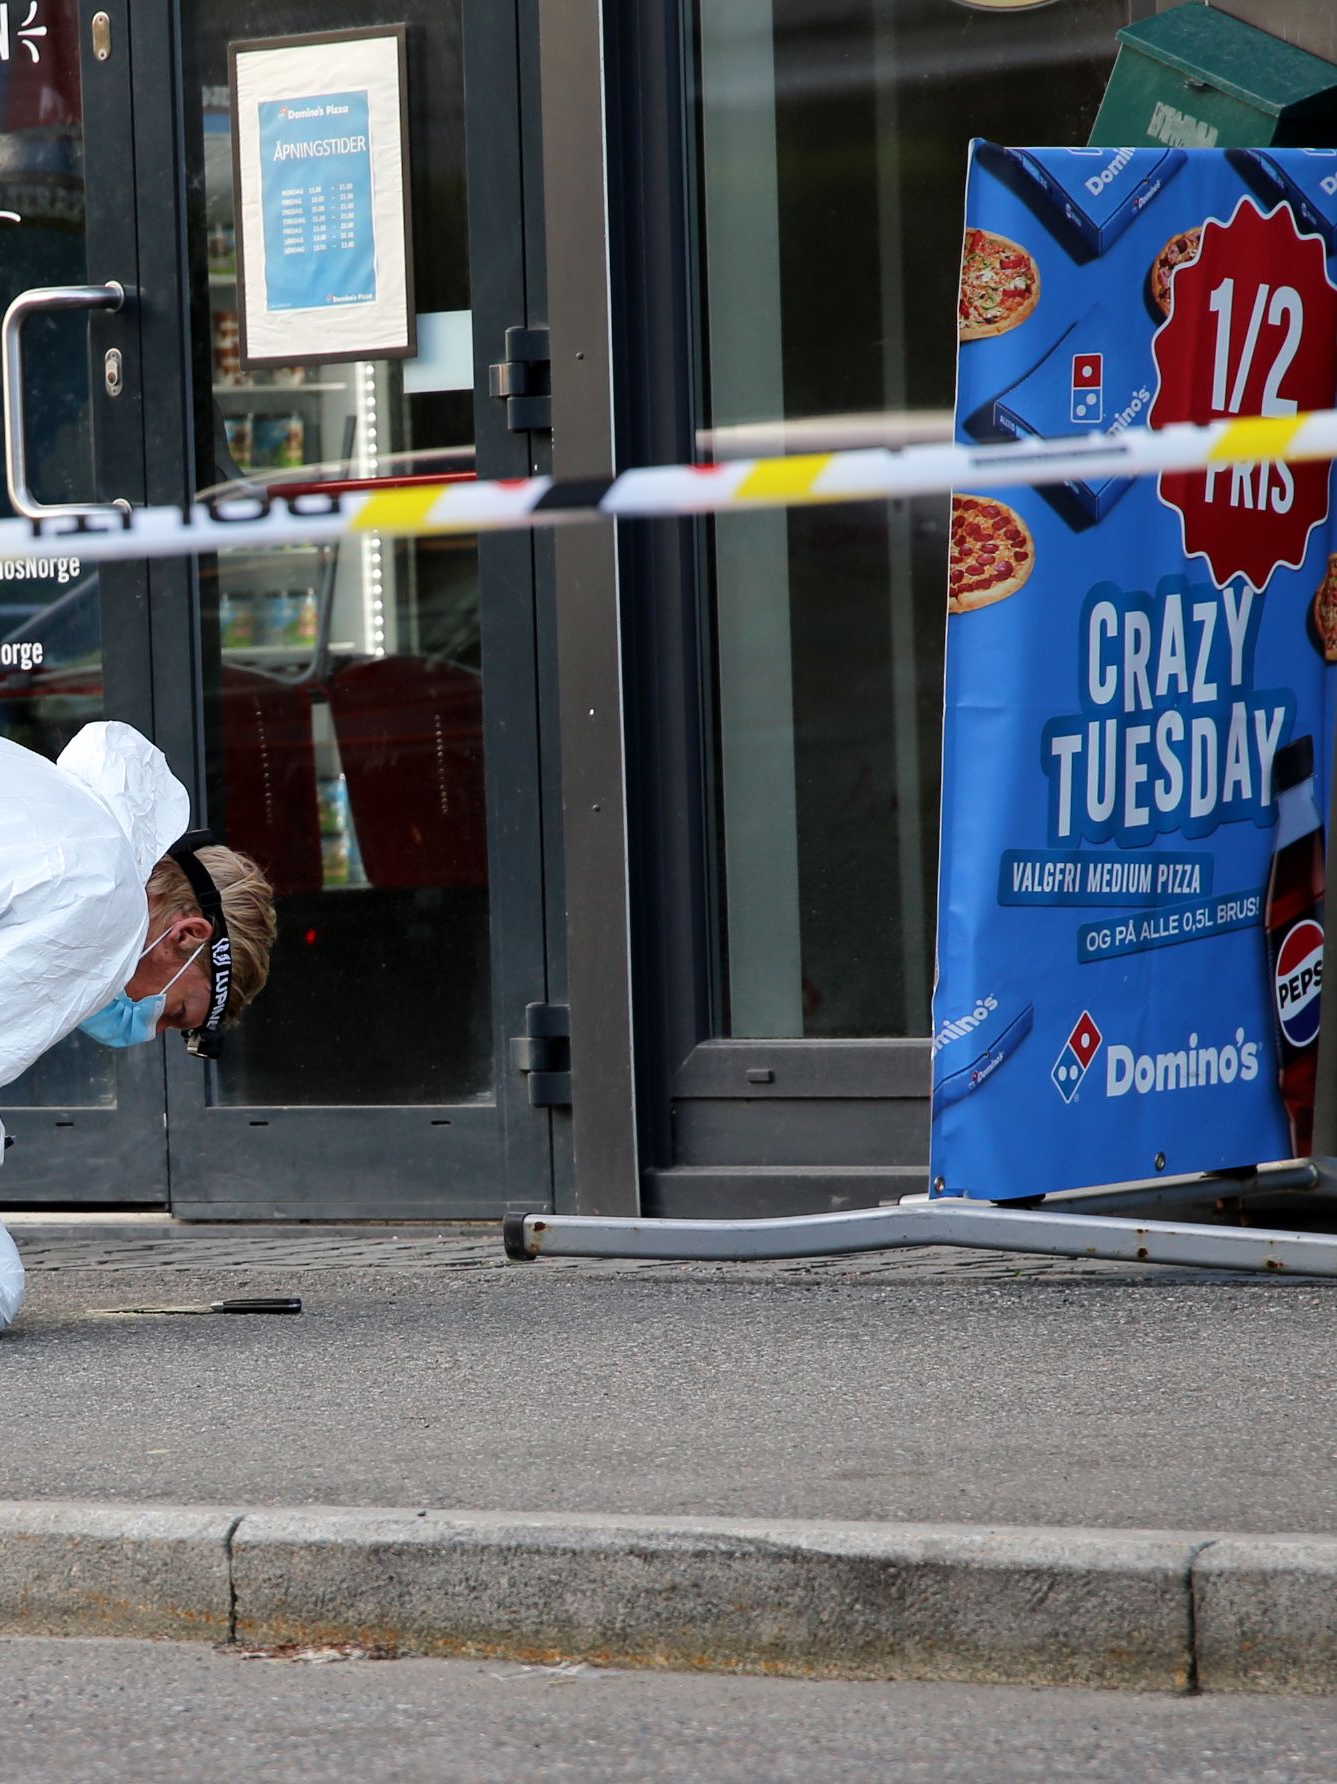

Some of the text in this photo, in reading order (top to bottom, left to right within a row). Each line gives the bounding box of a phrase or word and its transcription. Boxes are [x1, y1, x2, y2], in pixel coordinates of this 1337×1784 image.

[326, 104, 349, 115] Pizza
[273, 136, 366, 161] ÅPNINGSTIDER
[1209, 277, 1304, 419] 1/2
[1088, 586, 1254, 713] CRAZY
[1051, 701, 1286, 837] TUESDAY
[1013, 862, 1201, 894] VALGFRI MEDIUM PIZZA
[1086, 896, 1261, 952] OG PÅ ALLE 0,5L BRUS!
[1106, 1026, 1259, 1098] Domino's
